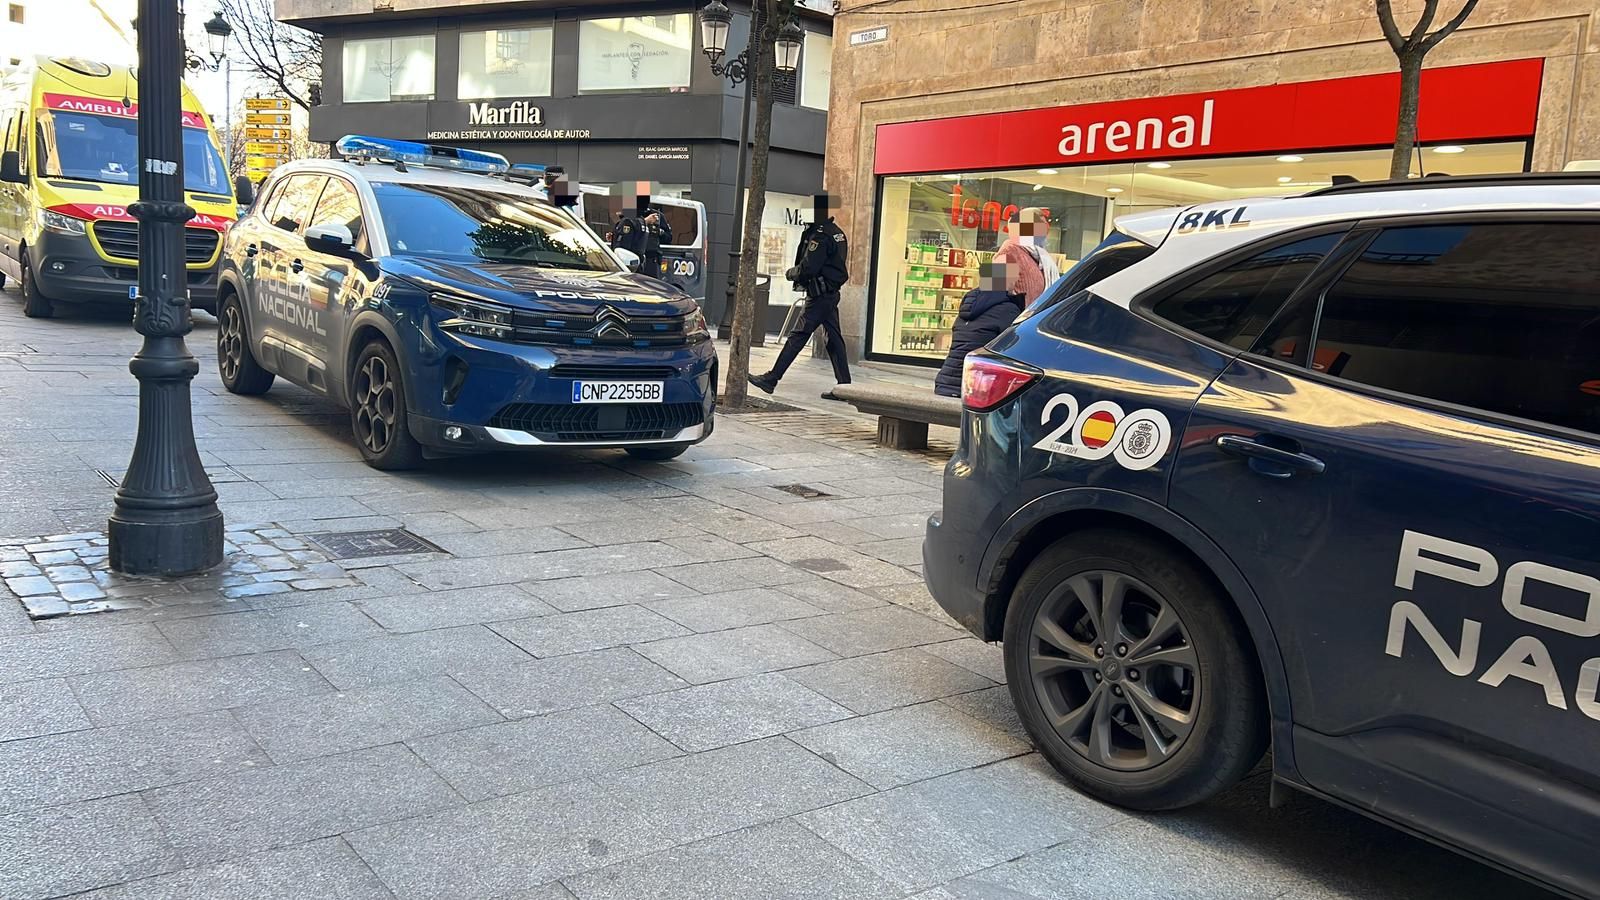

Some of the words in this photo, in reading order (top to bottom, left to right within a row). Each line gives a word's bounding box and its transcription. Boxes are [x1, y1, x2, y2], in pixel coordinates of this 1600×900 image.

[468, 100, 541, 125] Marfila
[427, 131, 459, 139] MEDICINA
[461, 130, 491, 139] ESTÉTICA
[492, 130, 498, 139] Y
[499, 129, 551, 139] ODONTOLOGÍA
[553, 130, 563, 138] DE
[565, 129, 590, 138] AUTOR
[1058, 99, 1214, 156] arenal
[1178, 205, 1251, 234] 8KL
[673, 260, 695, 276] 200
[374, 283, 391, 299] 091
[259, 291, 327, 336] NACIONAL
[581, 383, 661, 400] CNP2255BB
[1032, 393, 1172, 470] 200
